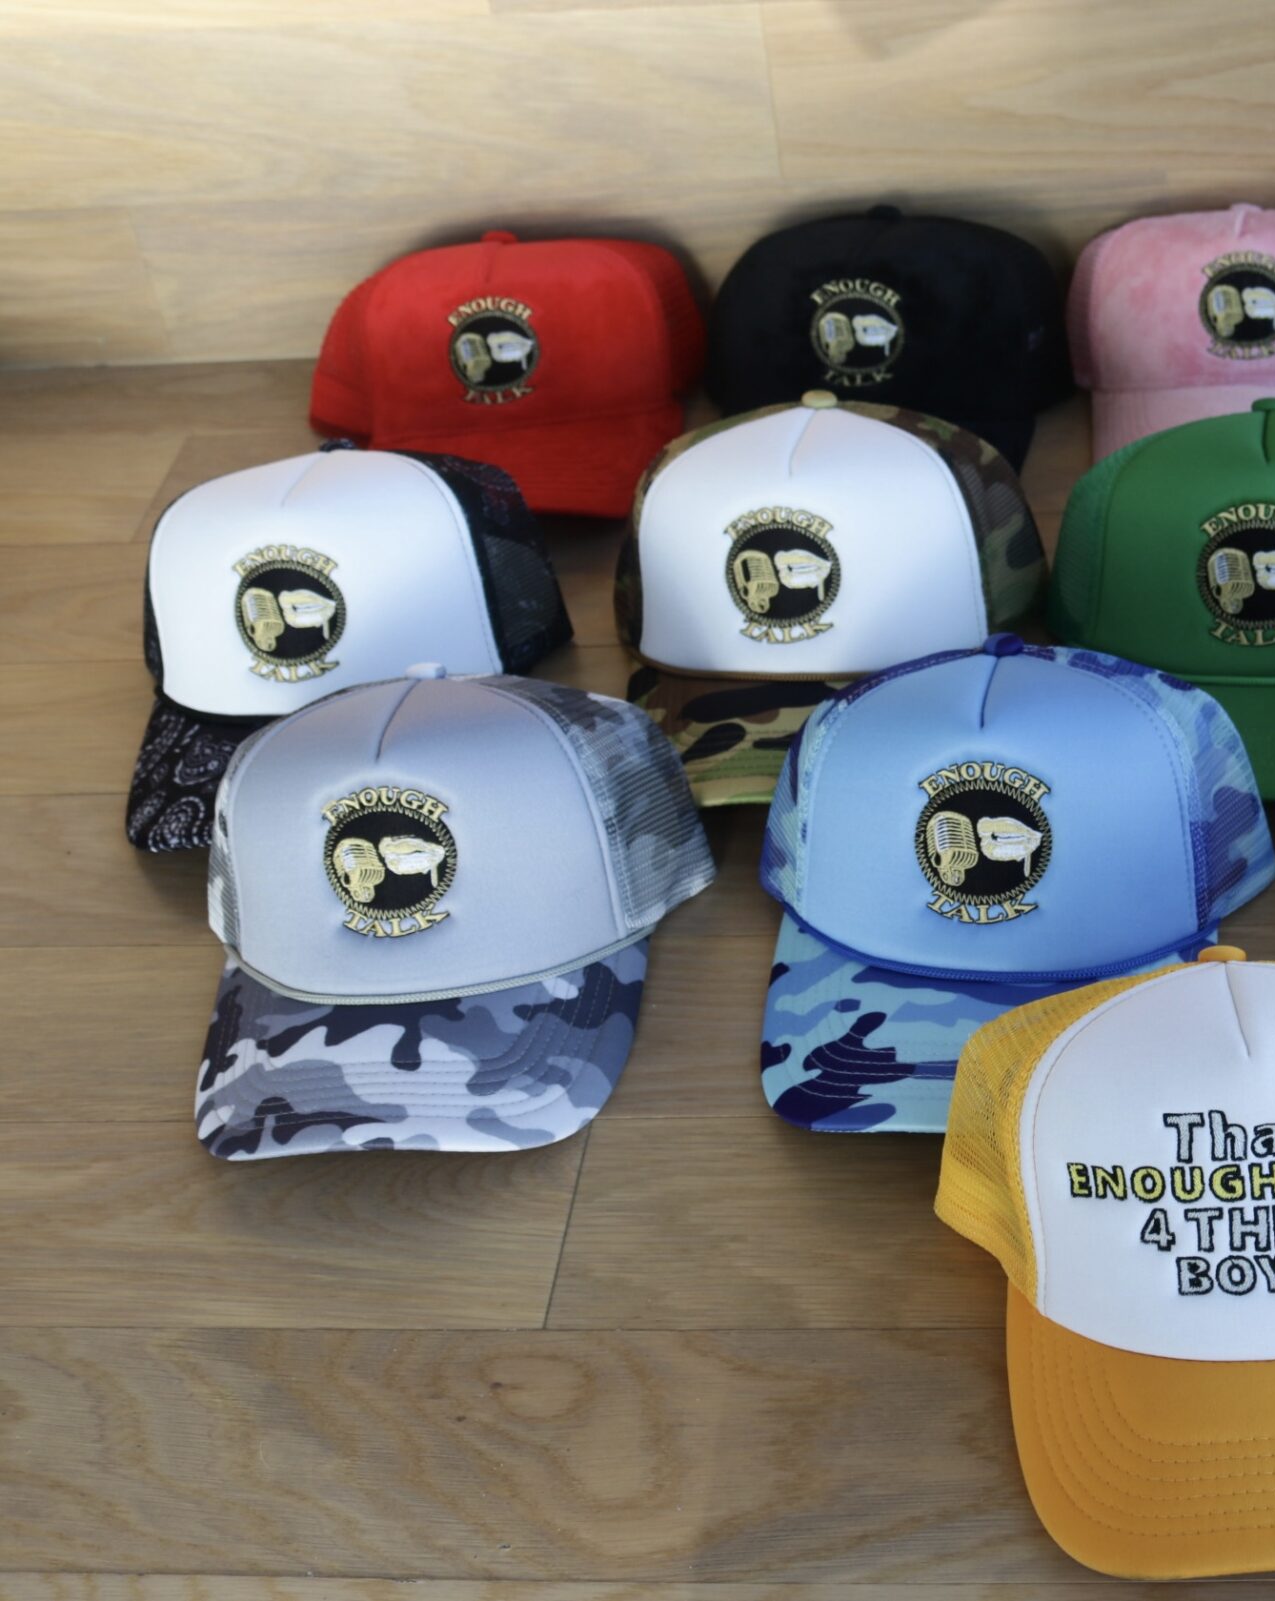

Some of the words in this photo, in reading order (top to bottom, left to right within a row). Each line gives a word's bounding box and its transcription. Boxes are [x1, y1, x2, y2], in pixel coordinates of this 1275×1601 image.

[724, 506, 834, 541] ENOUGH
[232, 544, 338, 577] ENOUGH
[740, 619, 834, 644] TALK
[918, 761, 1051, 803] ENOUGH
[320, 786, 448, 826] ENOUGH
[343, 903, 450, 938] TALK
[927, 890, 1038, 924] TALK
